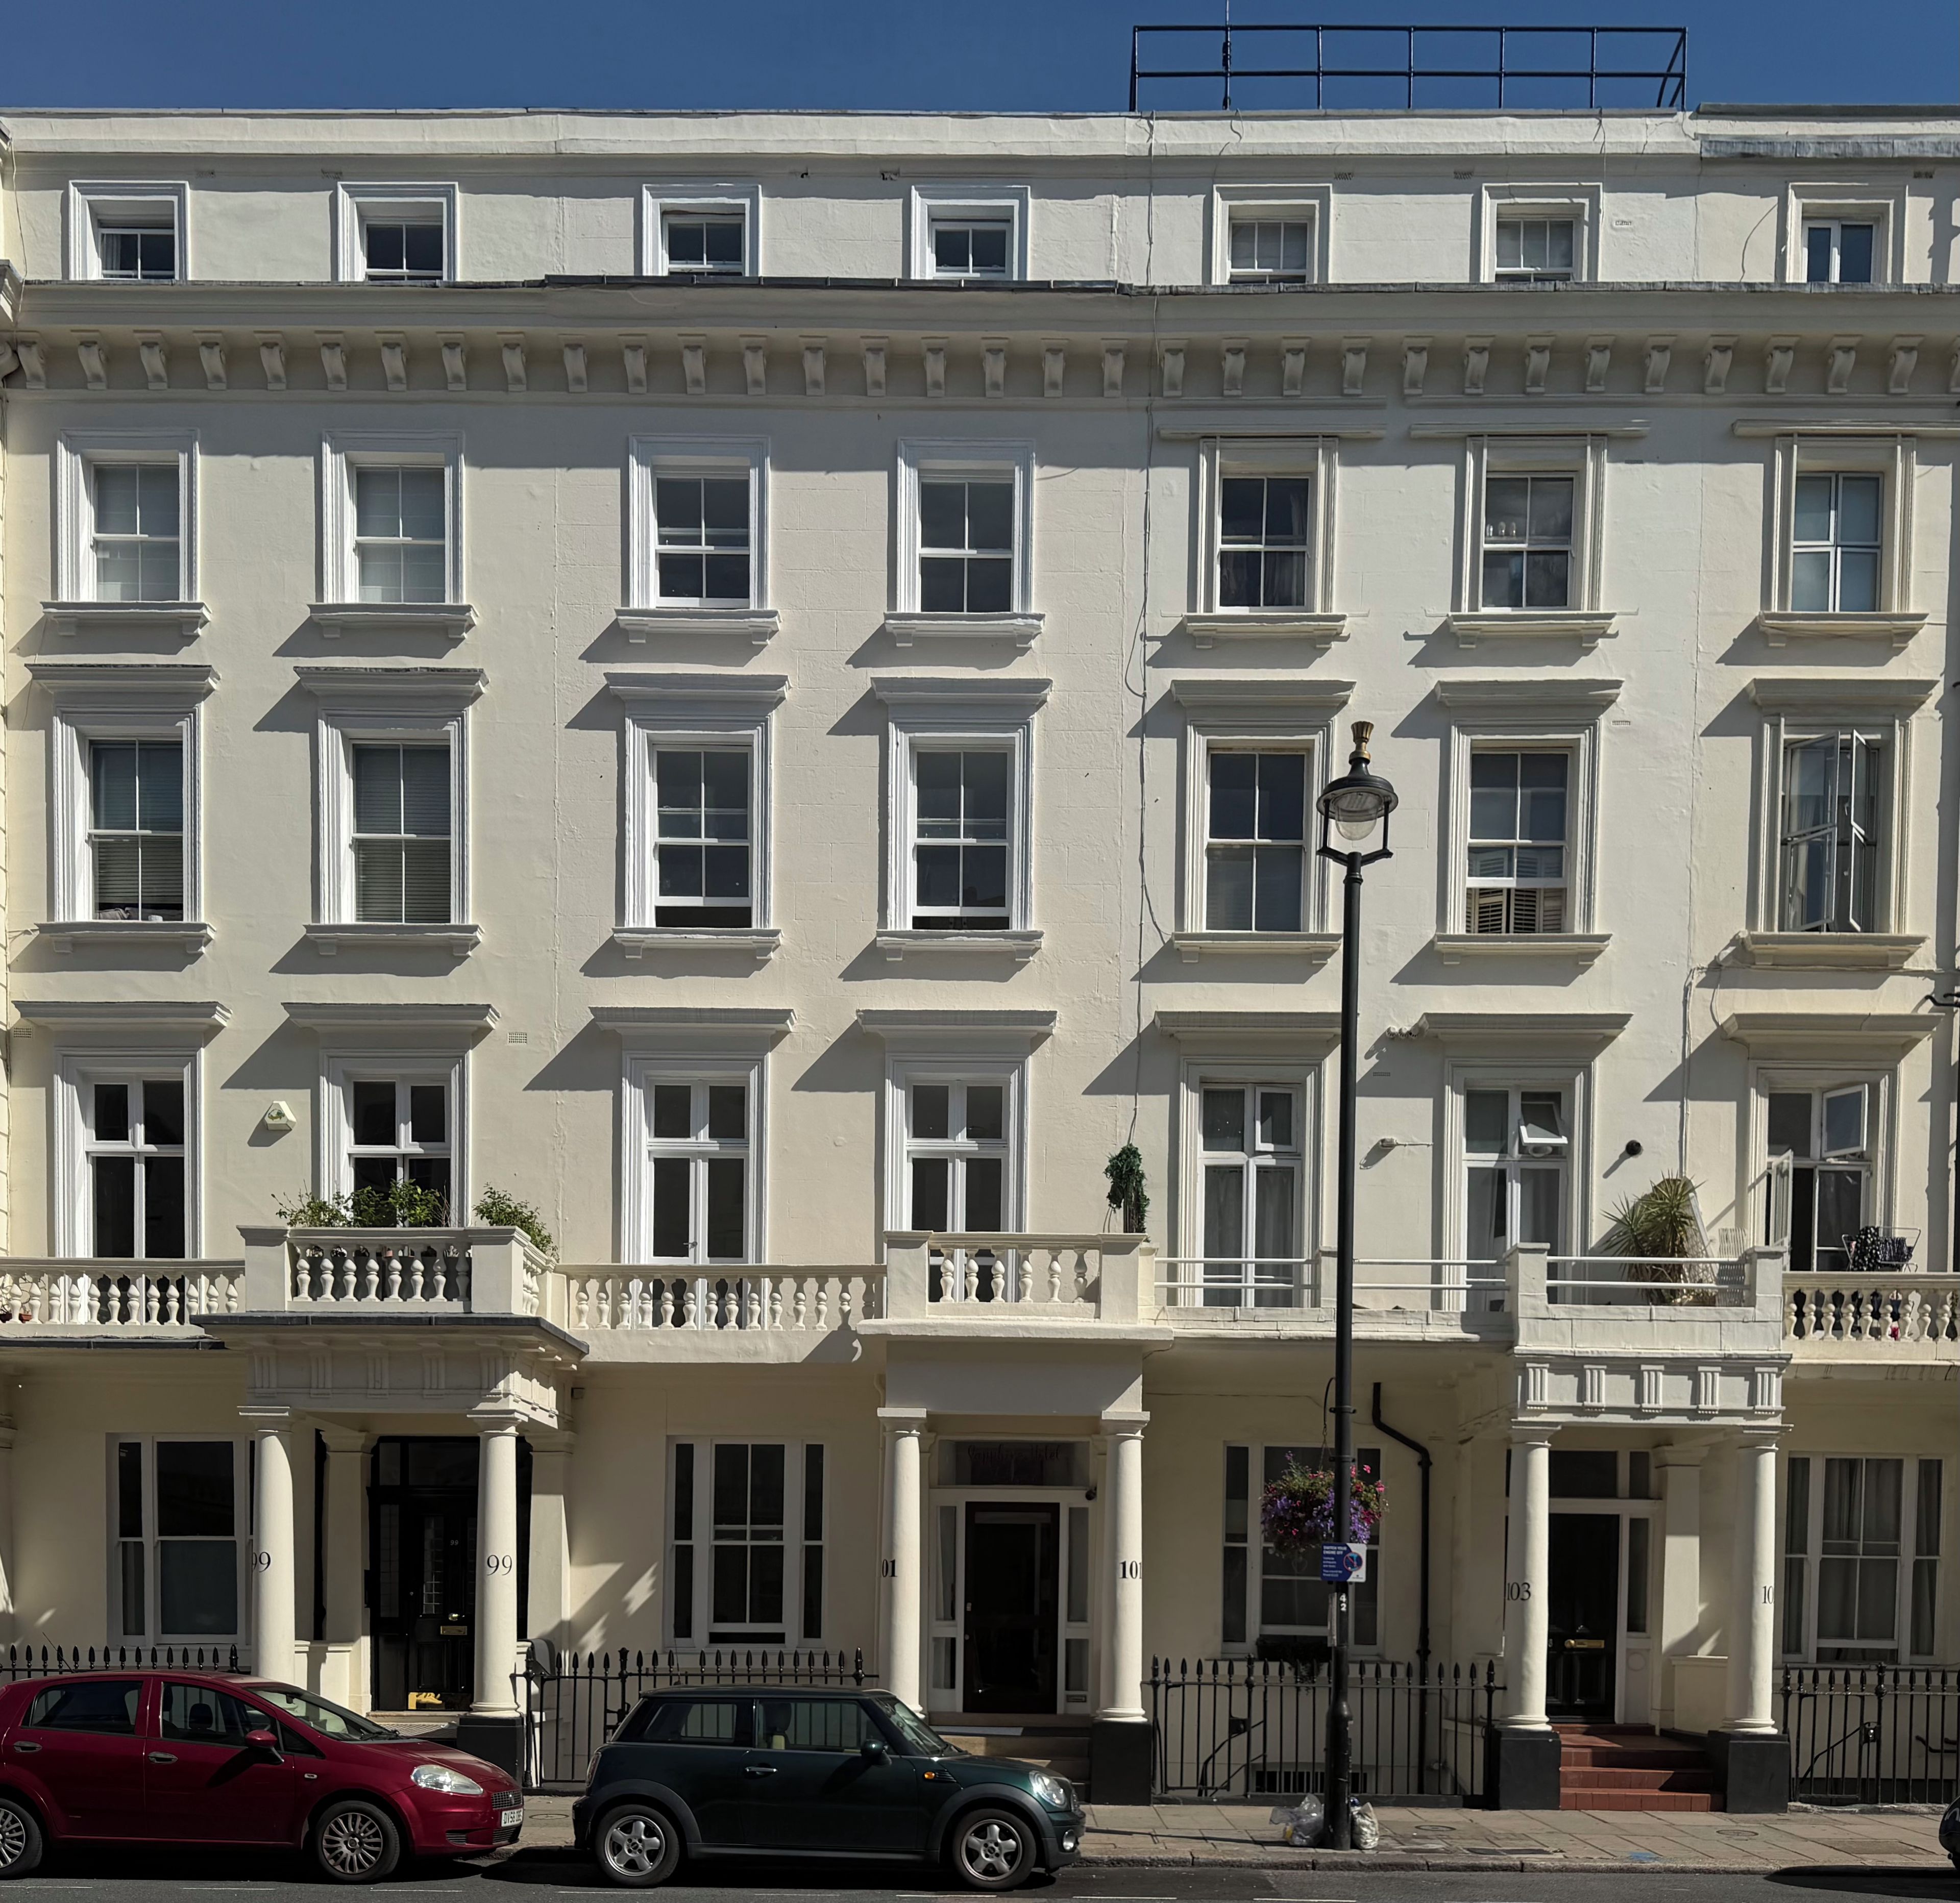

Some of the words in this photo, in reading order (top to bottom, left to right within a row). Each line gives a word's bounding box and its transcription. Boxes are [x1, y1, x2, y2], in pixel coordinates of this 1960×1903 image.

[486, 1554, 512, 1576] 99
[1507, 1581, 1531, 1601] 103
[1761, 1585, 1775, 1604] 10
